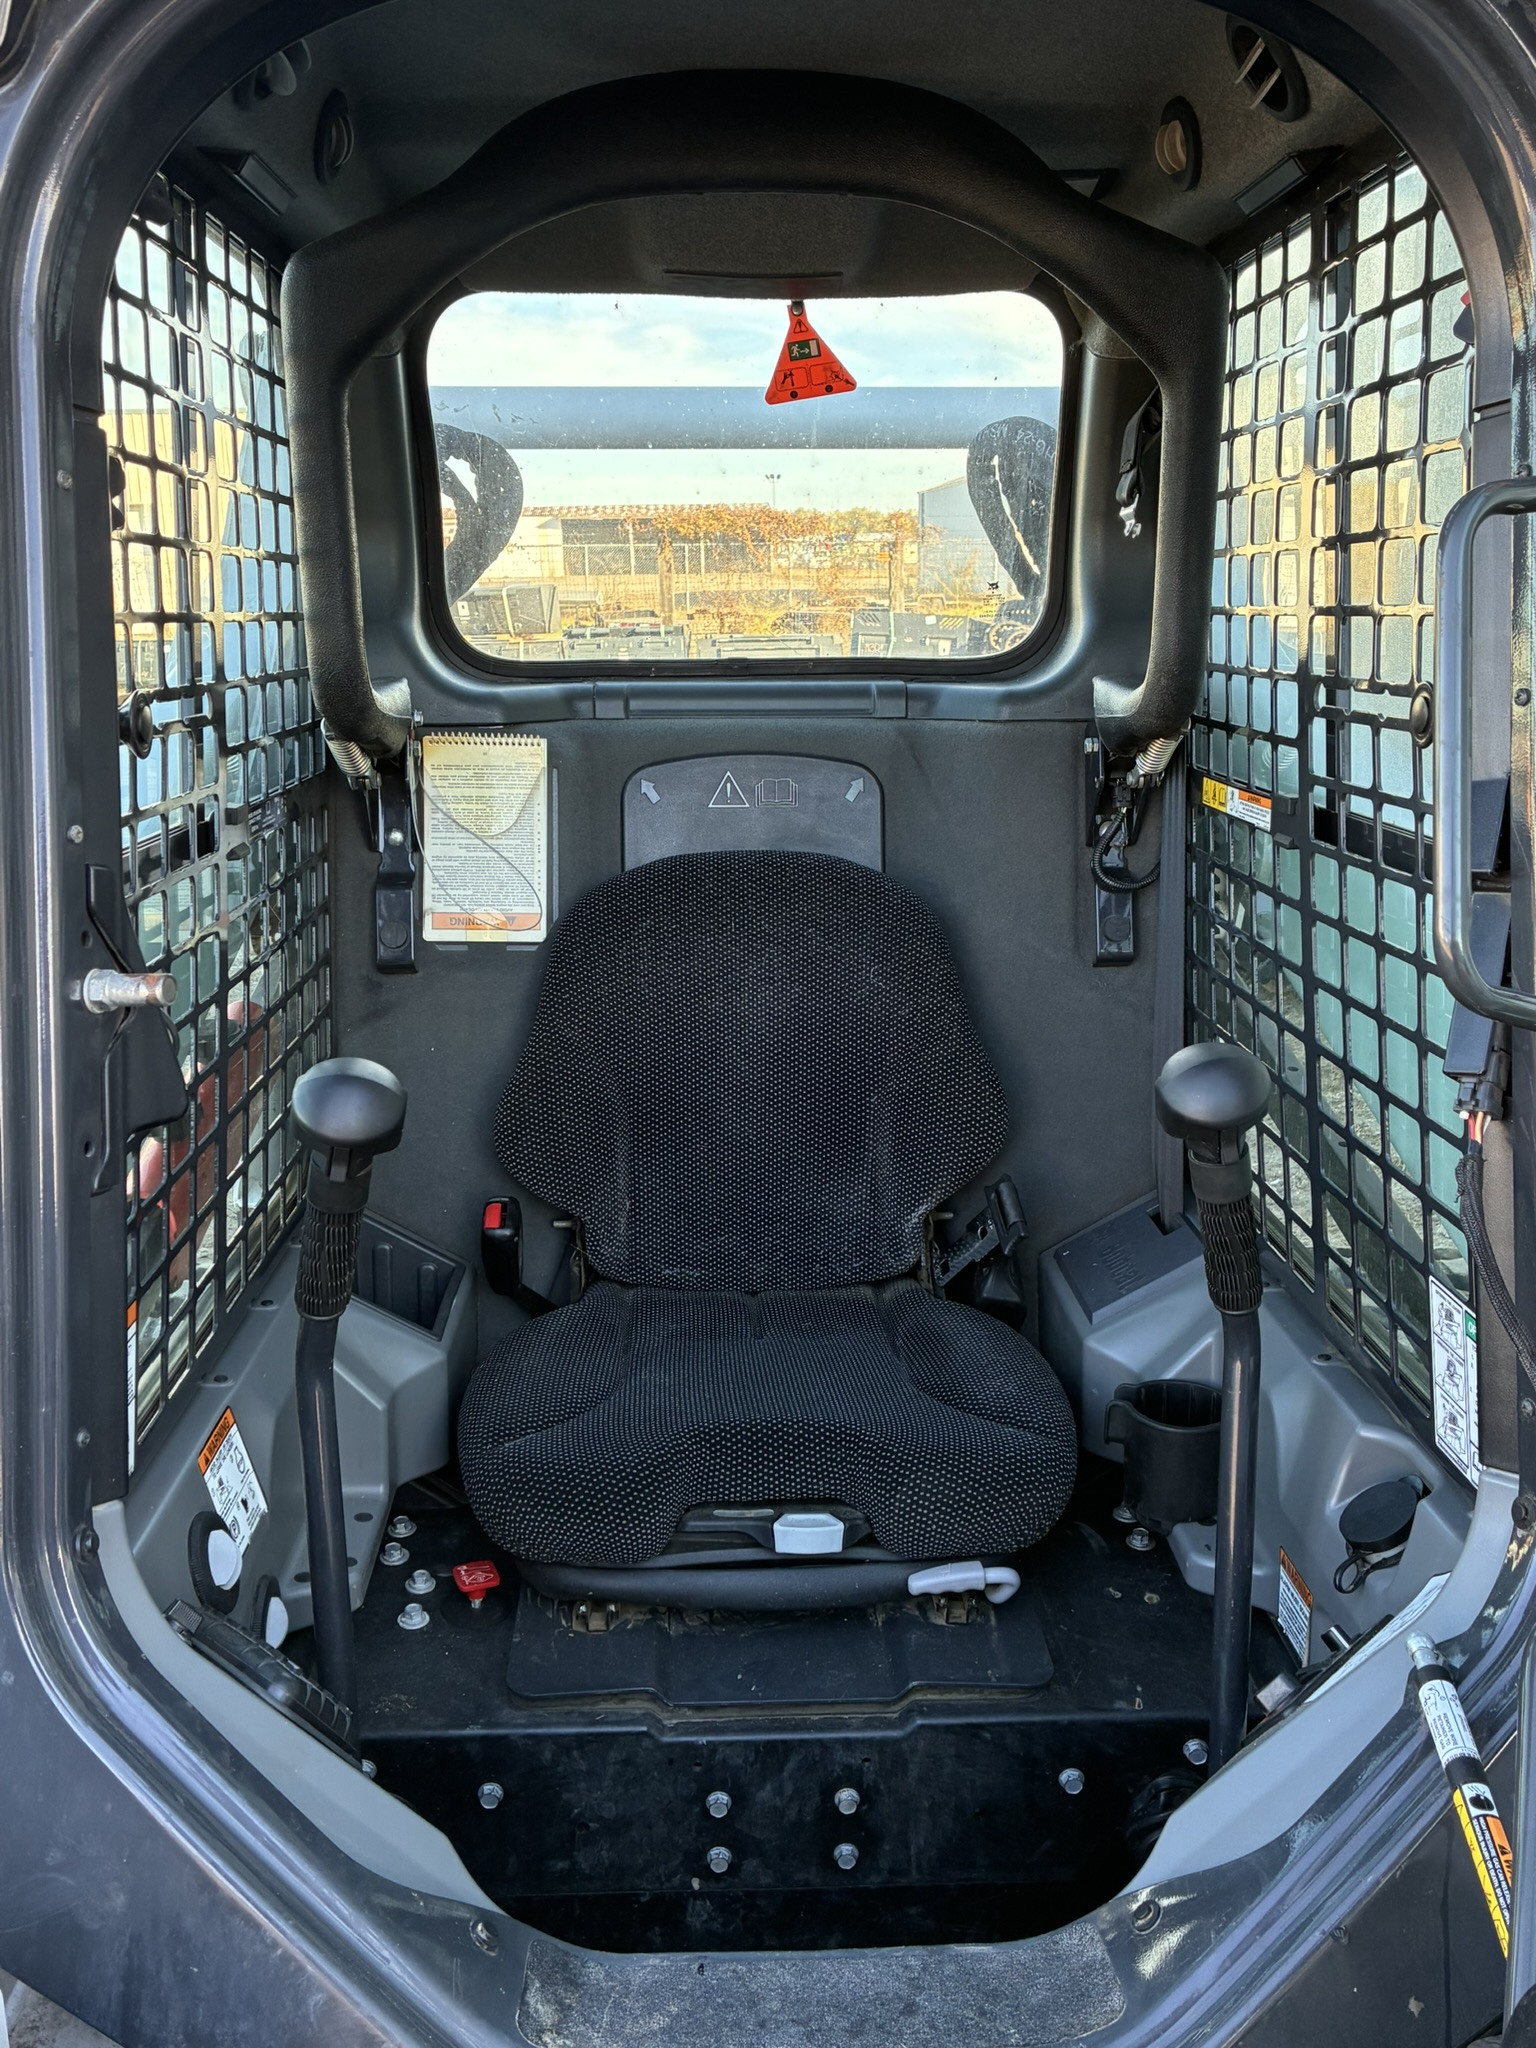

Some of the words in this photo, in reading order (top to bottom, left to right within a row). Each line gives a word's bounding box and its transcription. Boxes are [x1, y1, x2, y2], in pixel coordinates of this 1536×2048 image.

[1472, 1819, 1484, 1841] SERIOUS
[1480, 1841, 1490, 1860] INJURY
[1479, 1816, 1487, 1830] HIGH
[1483, 1830, 1497, 1857] PRESSURE
